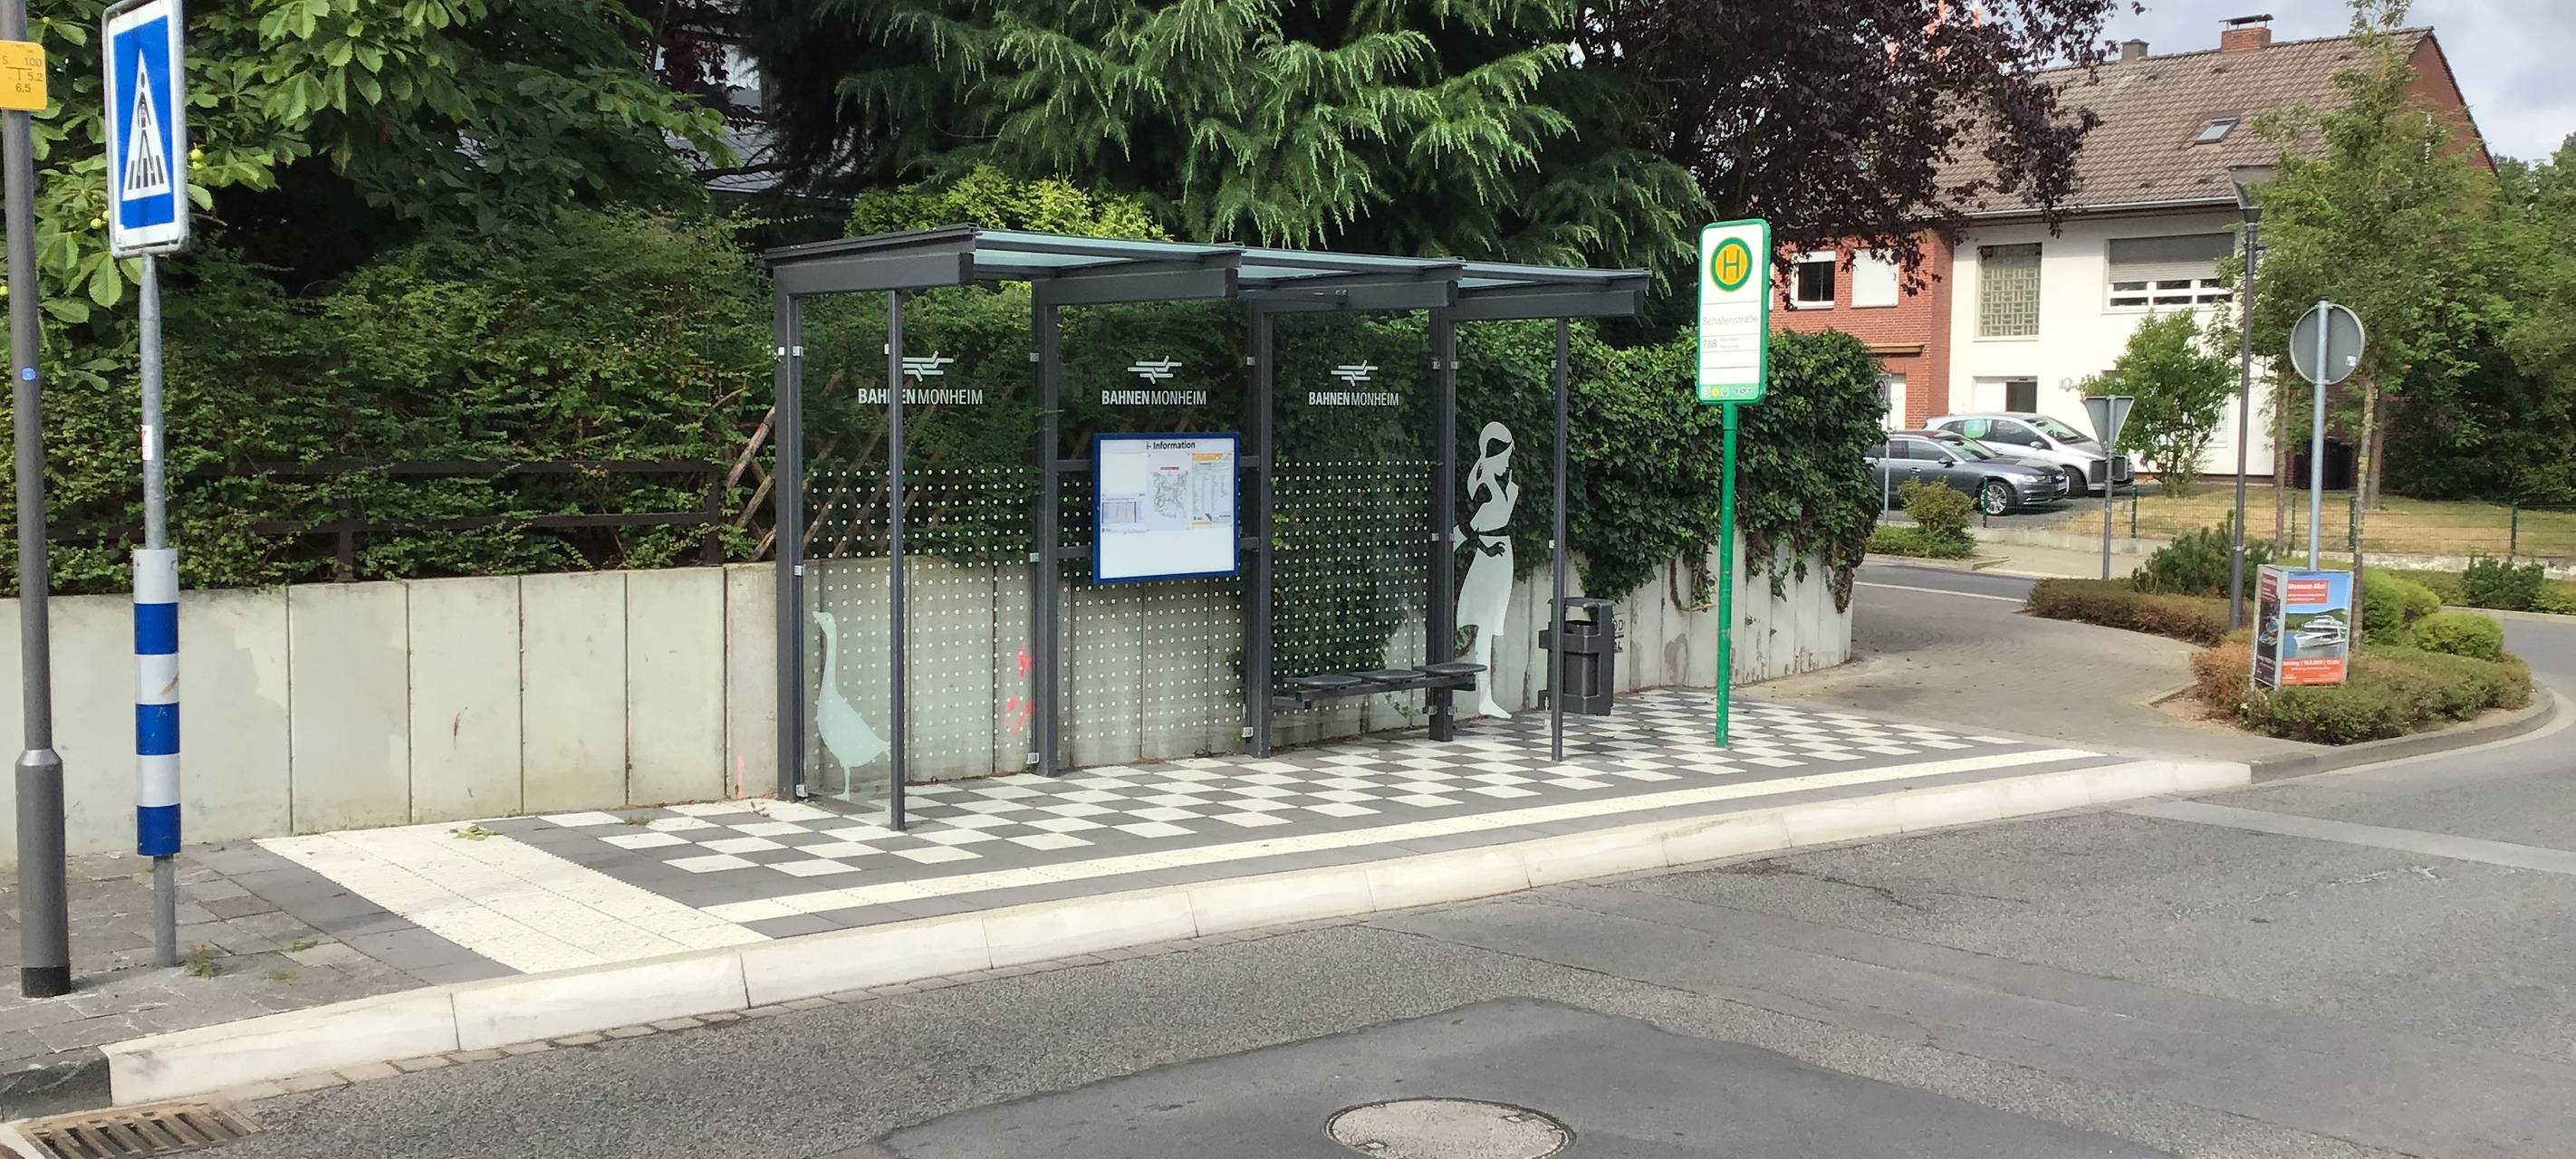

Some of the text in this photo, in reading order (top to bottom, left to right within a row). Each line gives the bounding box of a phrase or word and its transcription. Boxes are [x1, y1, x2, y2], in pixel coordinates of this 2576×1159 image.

[24, 57, 43, 67] 100
[15, 82, 31, 93] 6.5
[1722, 248, 1741, 280] H
[1153, 440, 1197, 450] Information
